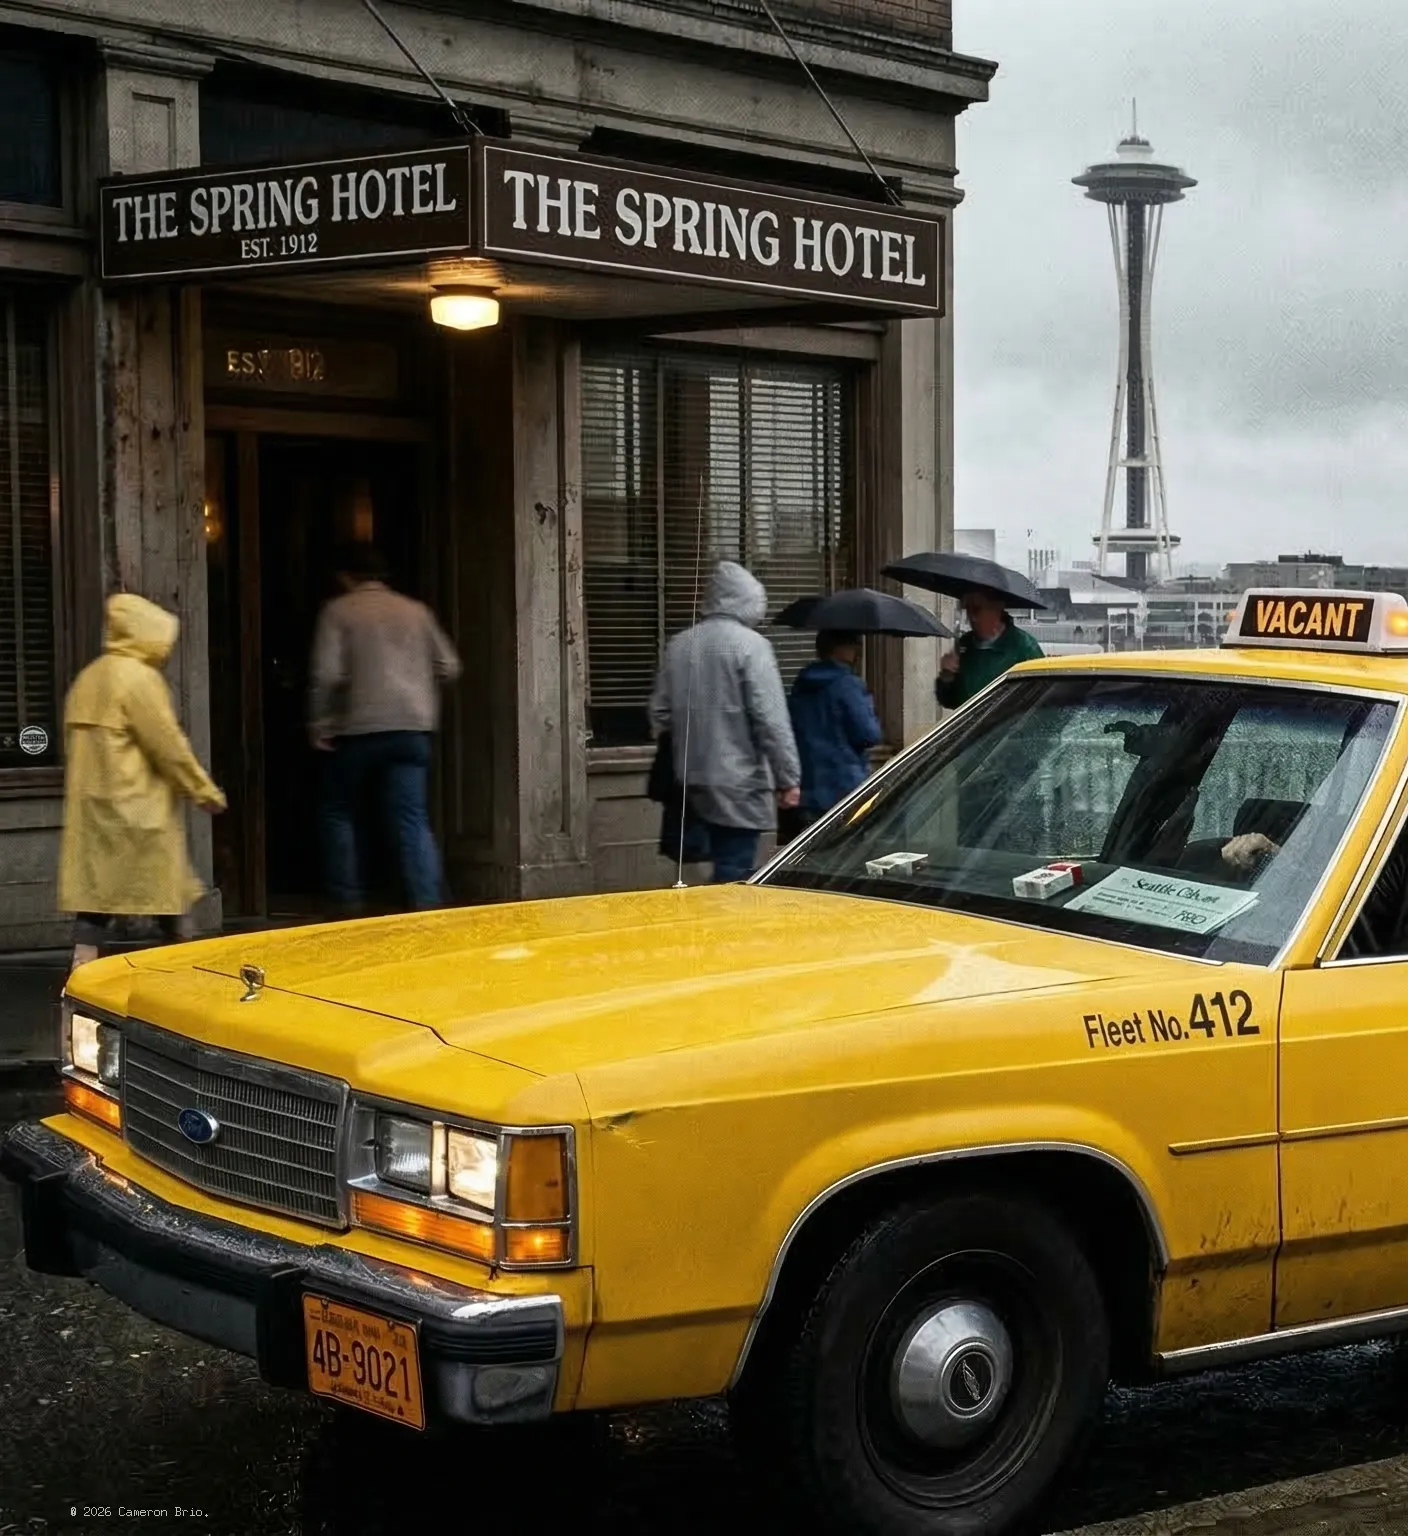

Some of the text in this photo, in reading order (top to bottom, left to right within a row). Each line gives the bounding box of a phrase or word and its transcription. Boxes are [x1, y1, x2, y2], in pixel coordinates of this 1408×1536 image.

[112, 163, 457, 242] THE SPRING HOTEL
[503, 170, 926, 287] THE SPRING HOTEL
[241, 233, 318, 259] EST. 1912
[1256, 600, 1363, 637] VACANT
[1083, 1012, 1146, 1048] Fleet
[313, 1329, 412, 1403] 4B-9021
